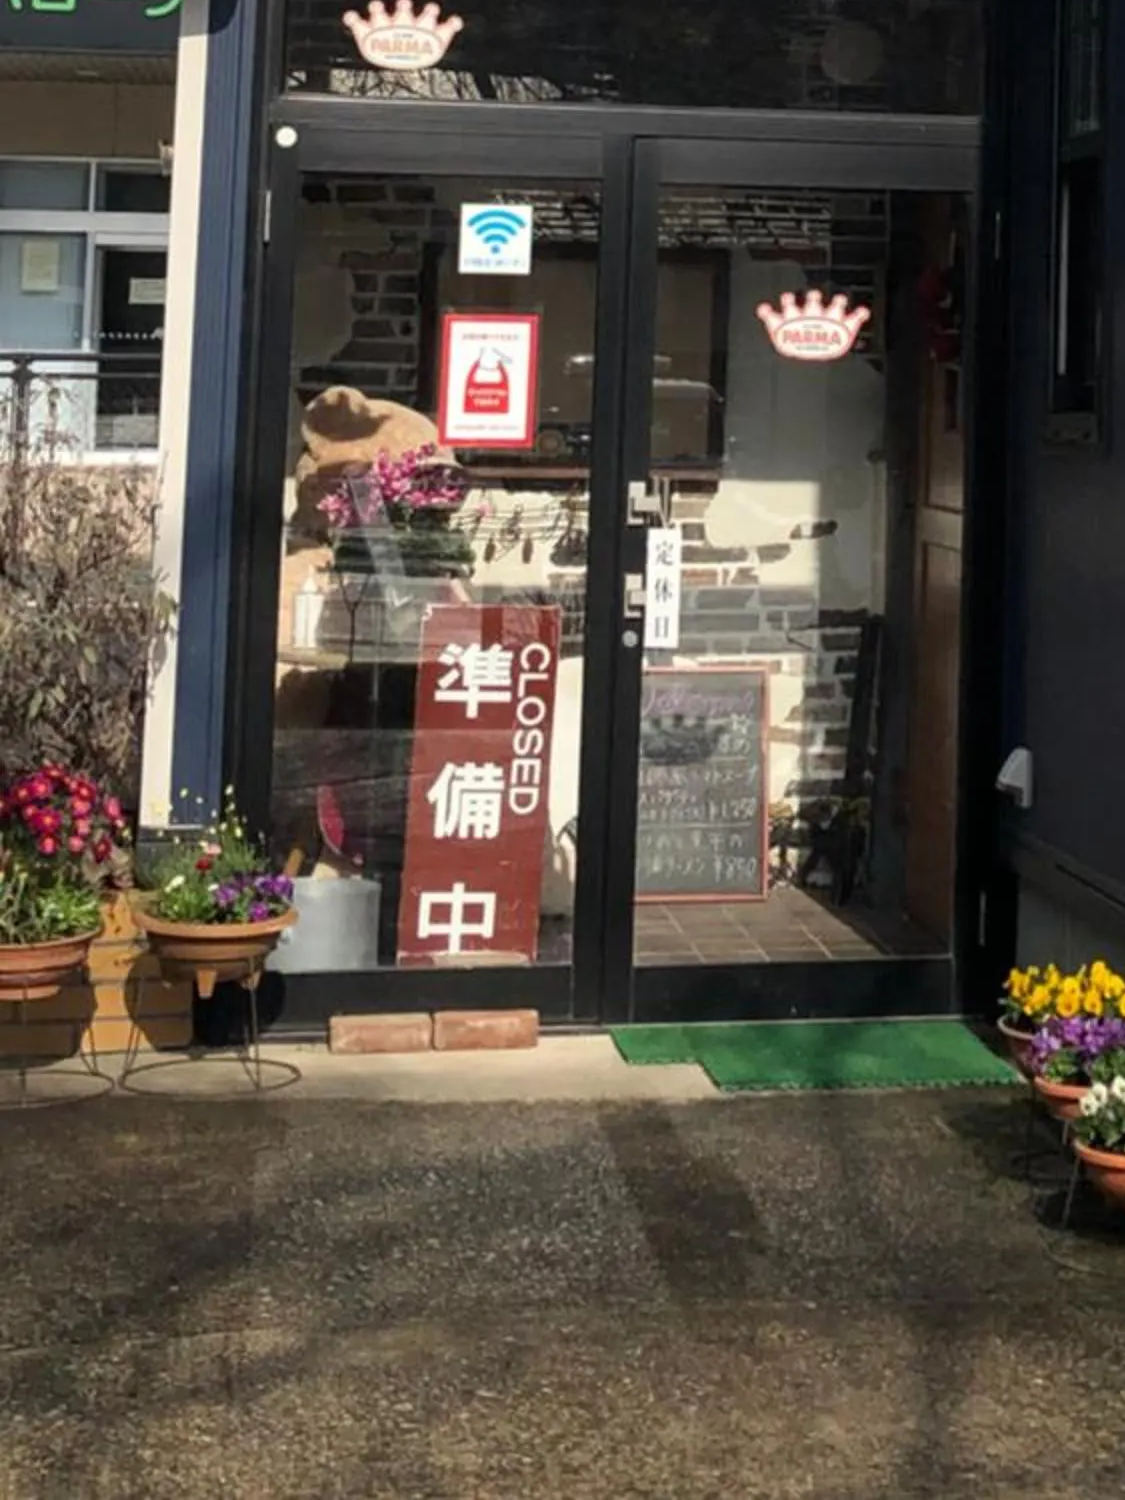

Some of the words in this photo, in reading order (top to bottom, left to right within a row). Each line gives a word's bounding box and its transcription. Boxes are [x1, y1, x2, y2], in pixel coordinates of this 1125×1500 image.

[655, 539, 675, 639] 定休日
[416, 642, 514, 955] 準備中
[508, 642, 551, 815] CLOSED
